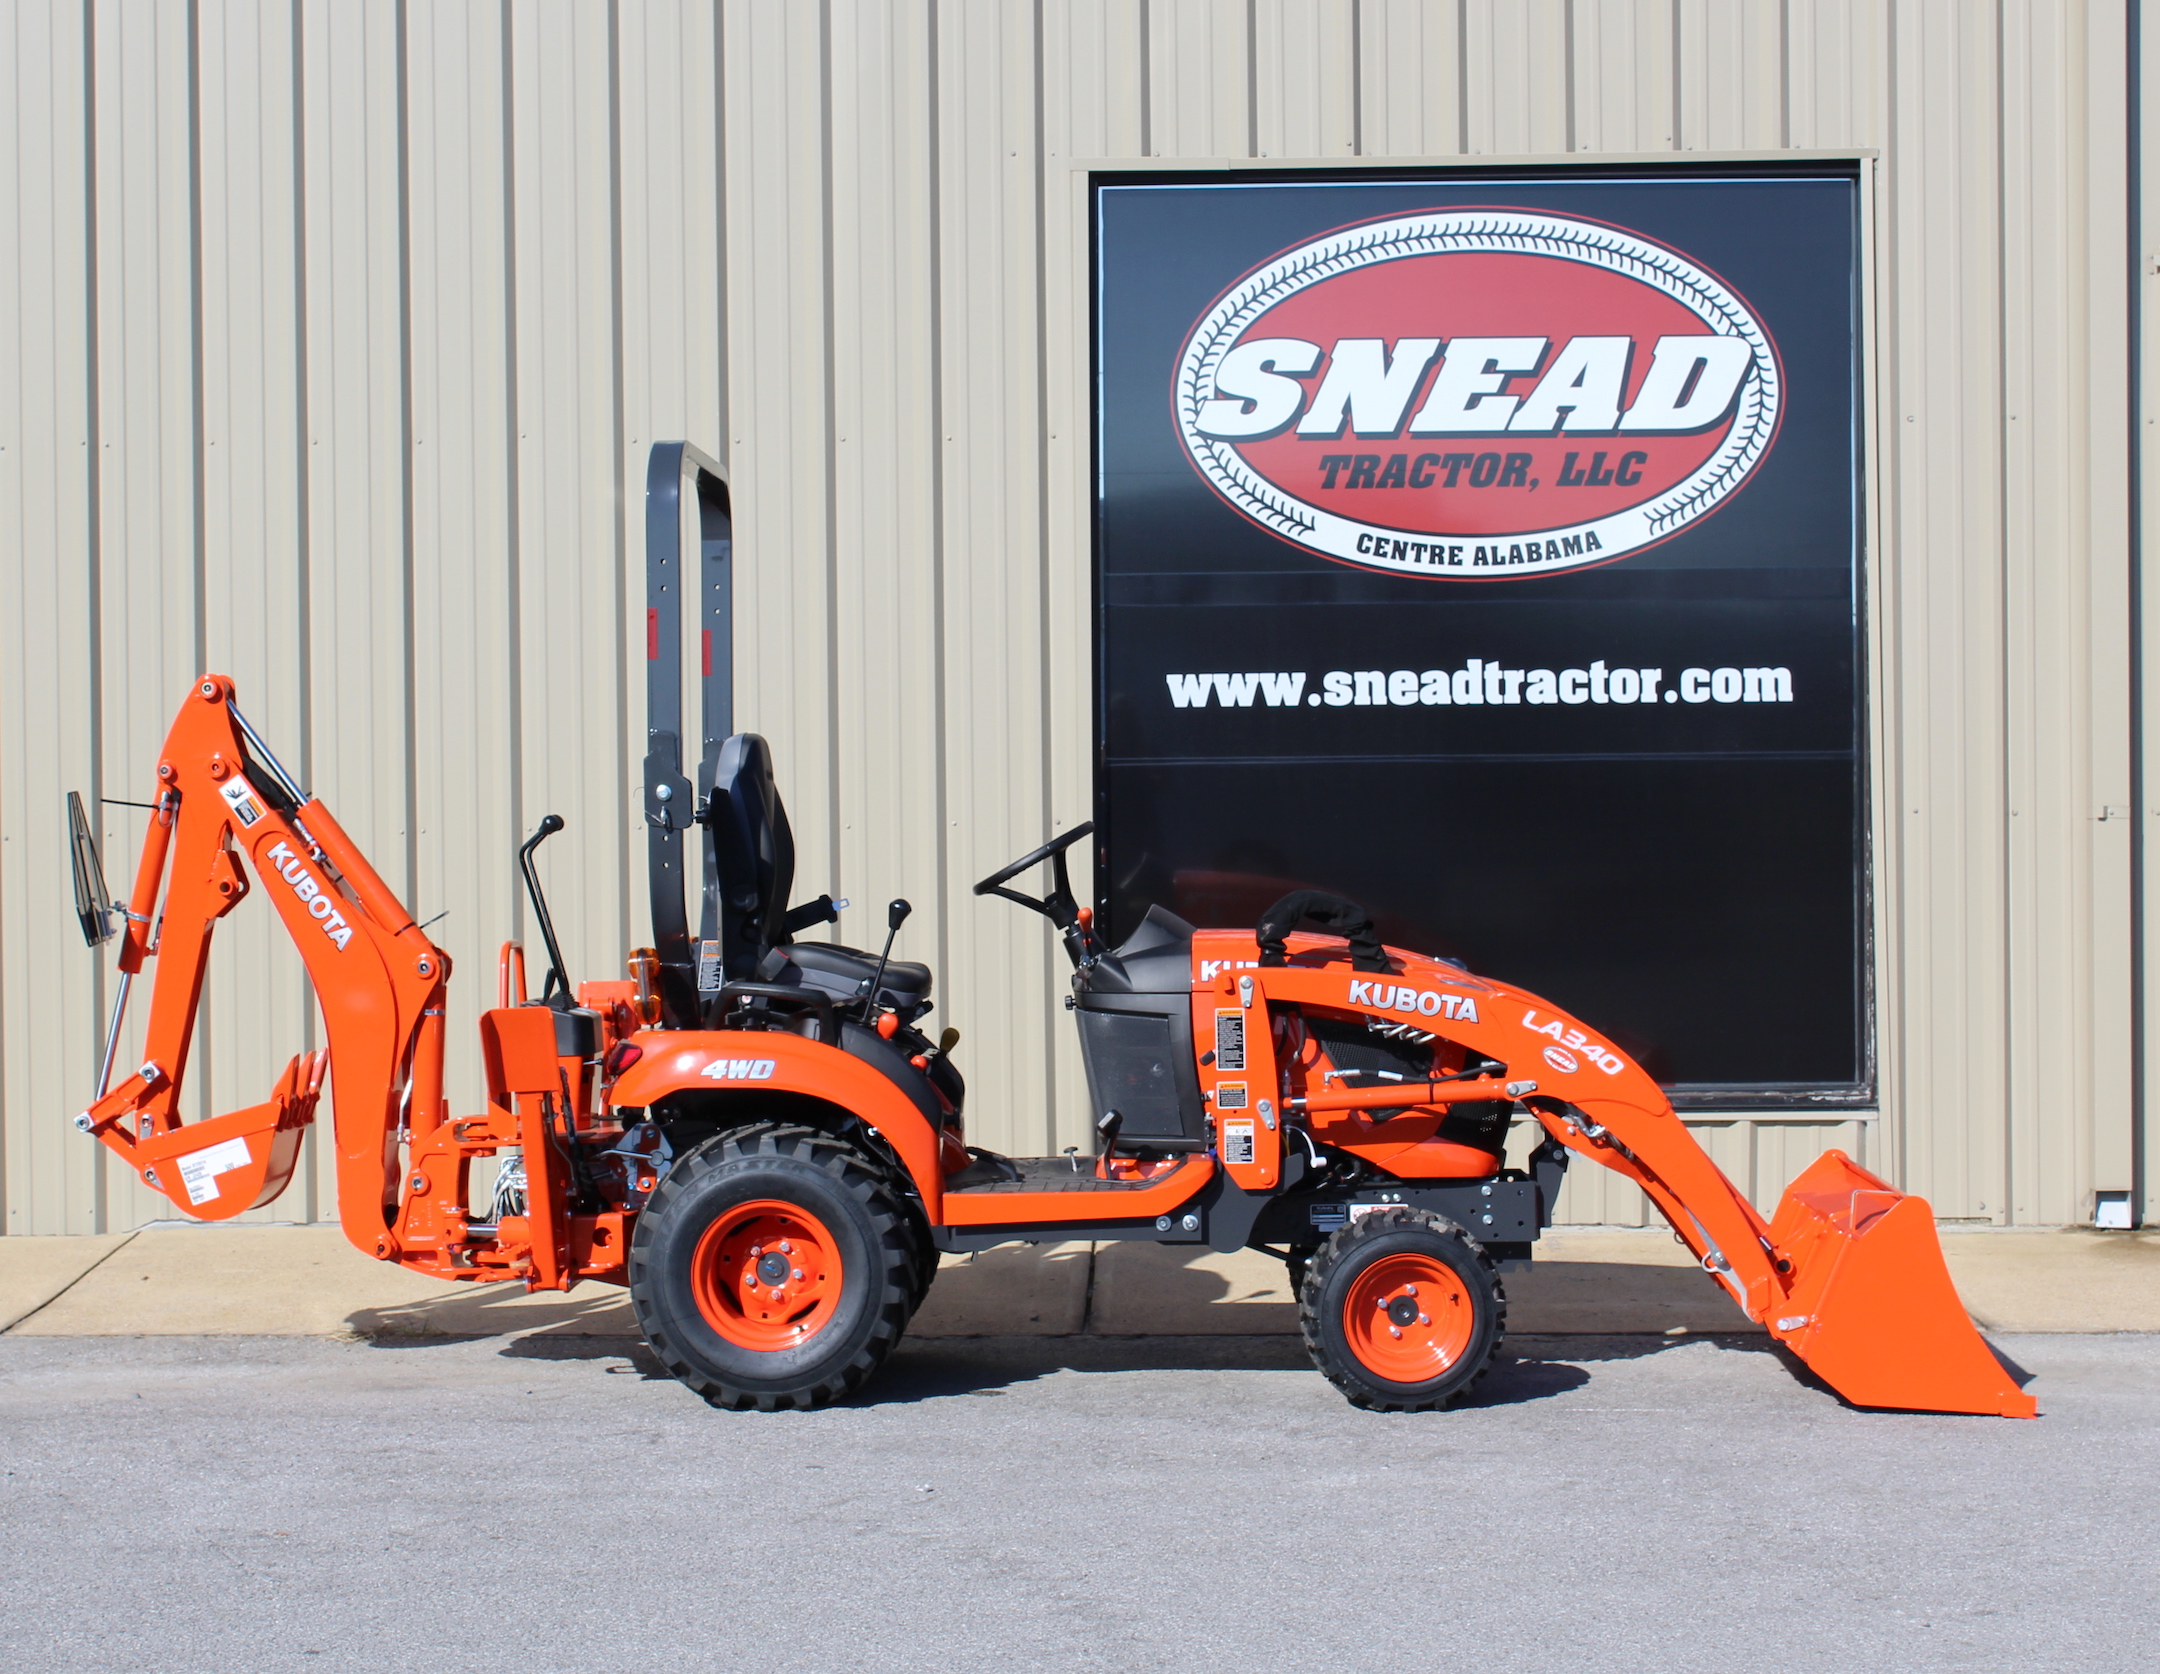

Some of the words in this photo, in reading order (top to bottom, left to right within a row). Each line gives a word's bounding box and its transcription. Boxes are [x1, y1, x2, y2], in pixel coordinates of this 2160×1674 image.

[1194, 335, 1755, 439] SNEAD
[1318, 452, 1540, 492] TRACTOR,
[1556, 451, 1648, 487] LLC
[1356, 533, 1464, 566] CENTRE
[1473, 530, 1603, 567] ALABAMA
[1166, 659, 1793, 708] www.sneadtractor.com
[266, 841, 354, 952] KUBOTA
[1348, 980, 1480, 1024] KUBOTA
[1522, 1010, 1625, 1075] LA340
[701, 1059, 776, 1080] 4WD
